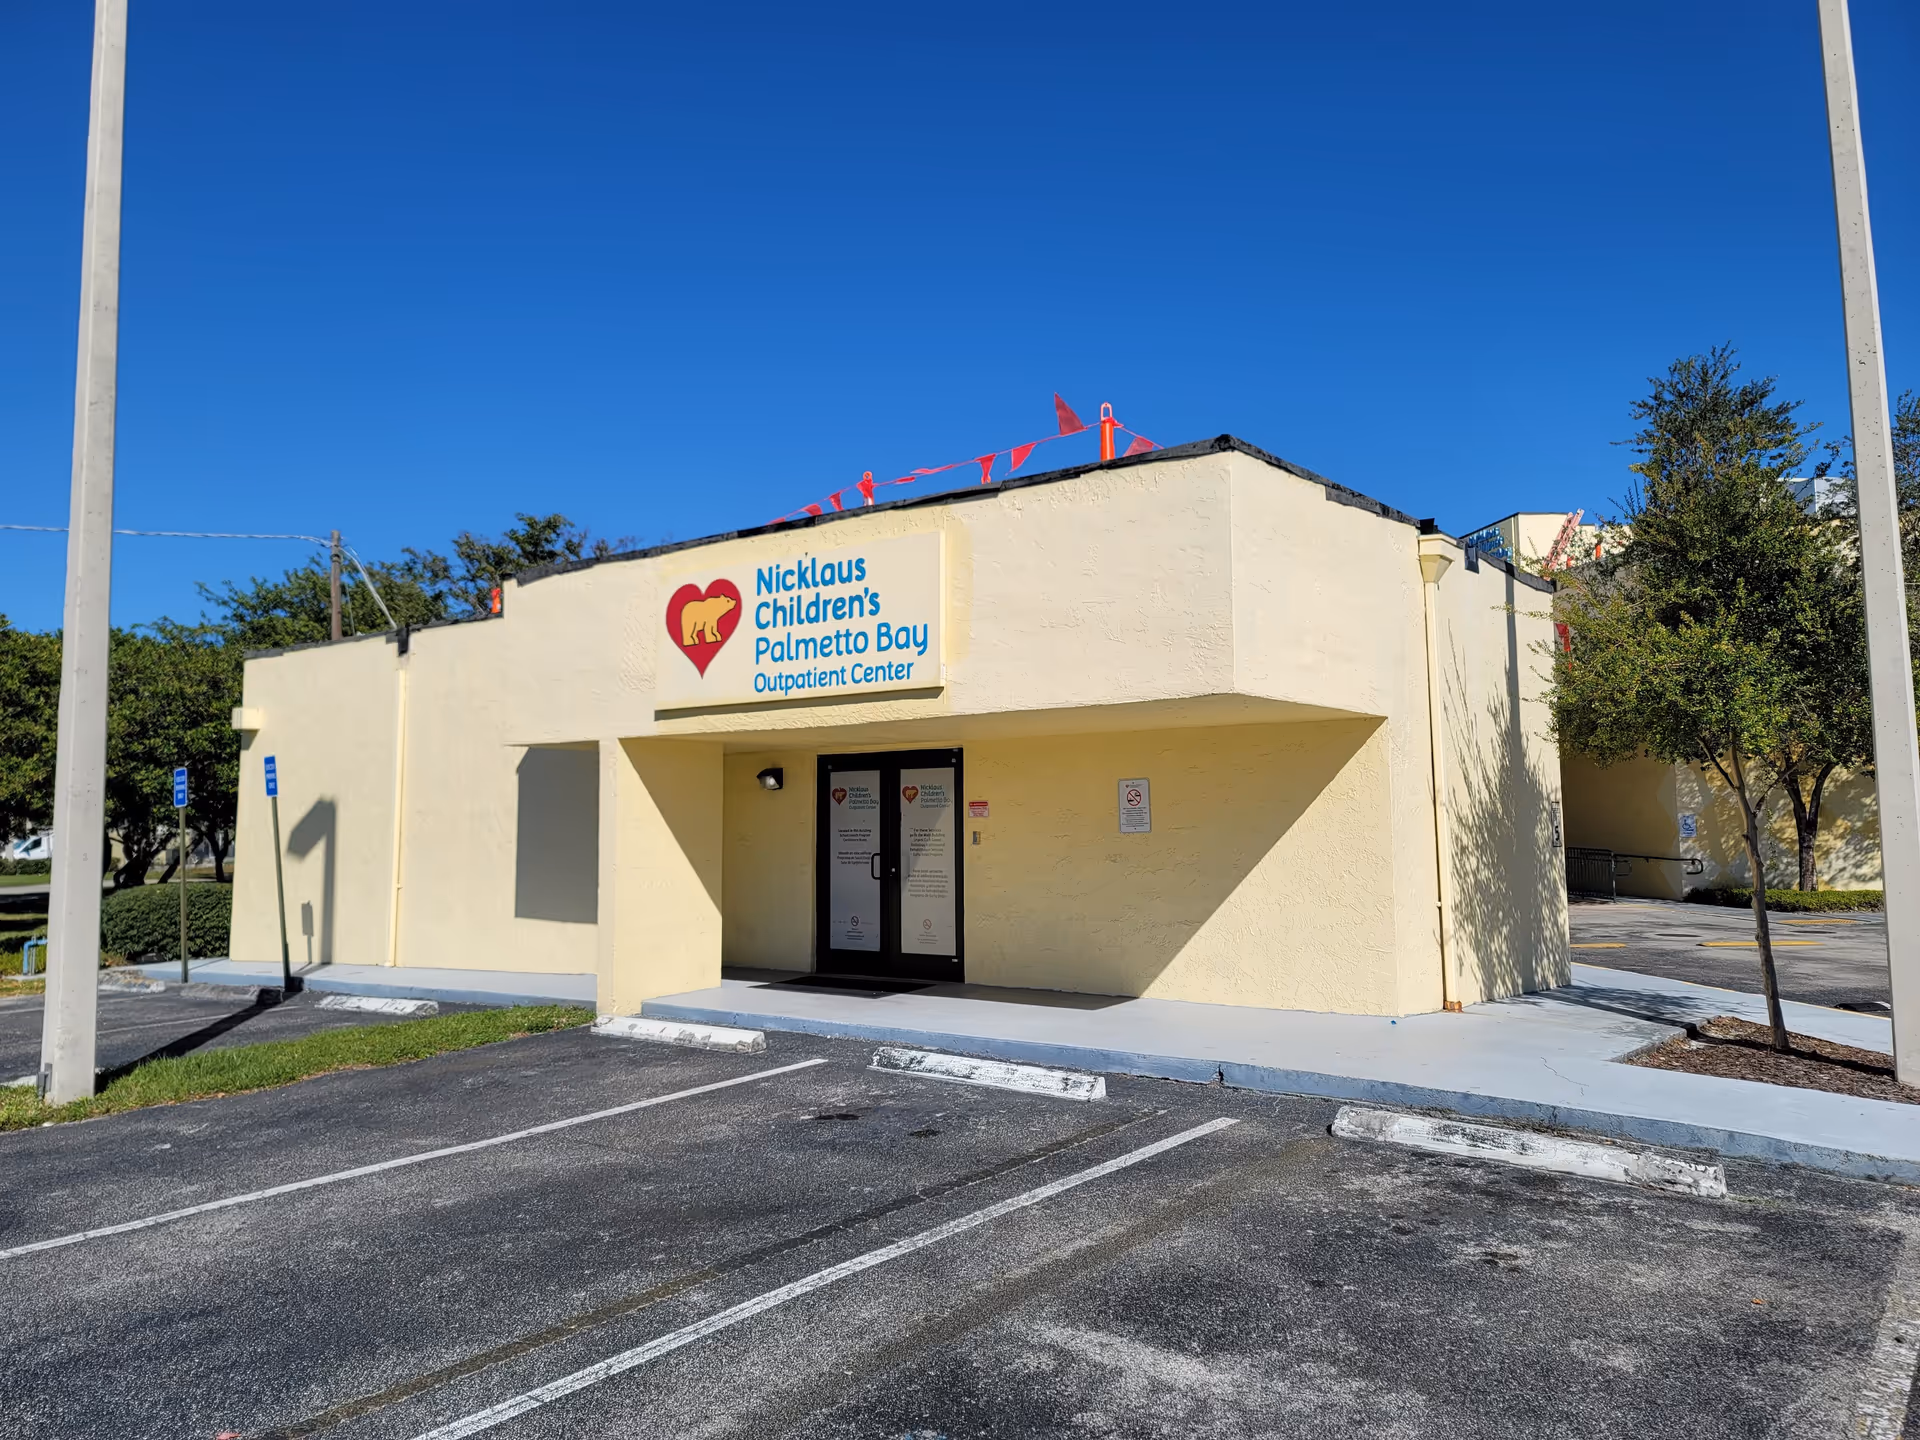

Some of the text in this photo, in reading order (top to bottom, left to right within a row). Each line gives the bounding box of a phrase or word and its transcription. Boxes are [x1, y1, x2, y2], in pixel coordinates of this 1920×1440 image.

[757, 558, 867, 596] Nicklaus
[755, 587, 881, 629] Children's
[756, 622, 929, 664] Palmetto Bay
[754, 662, 915, 695] Outpatient Center
